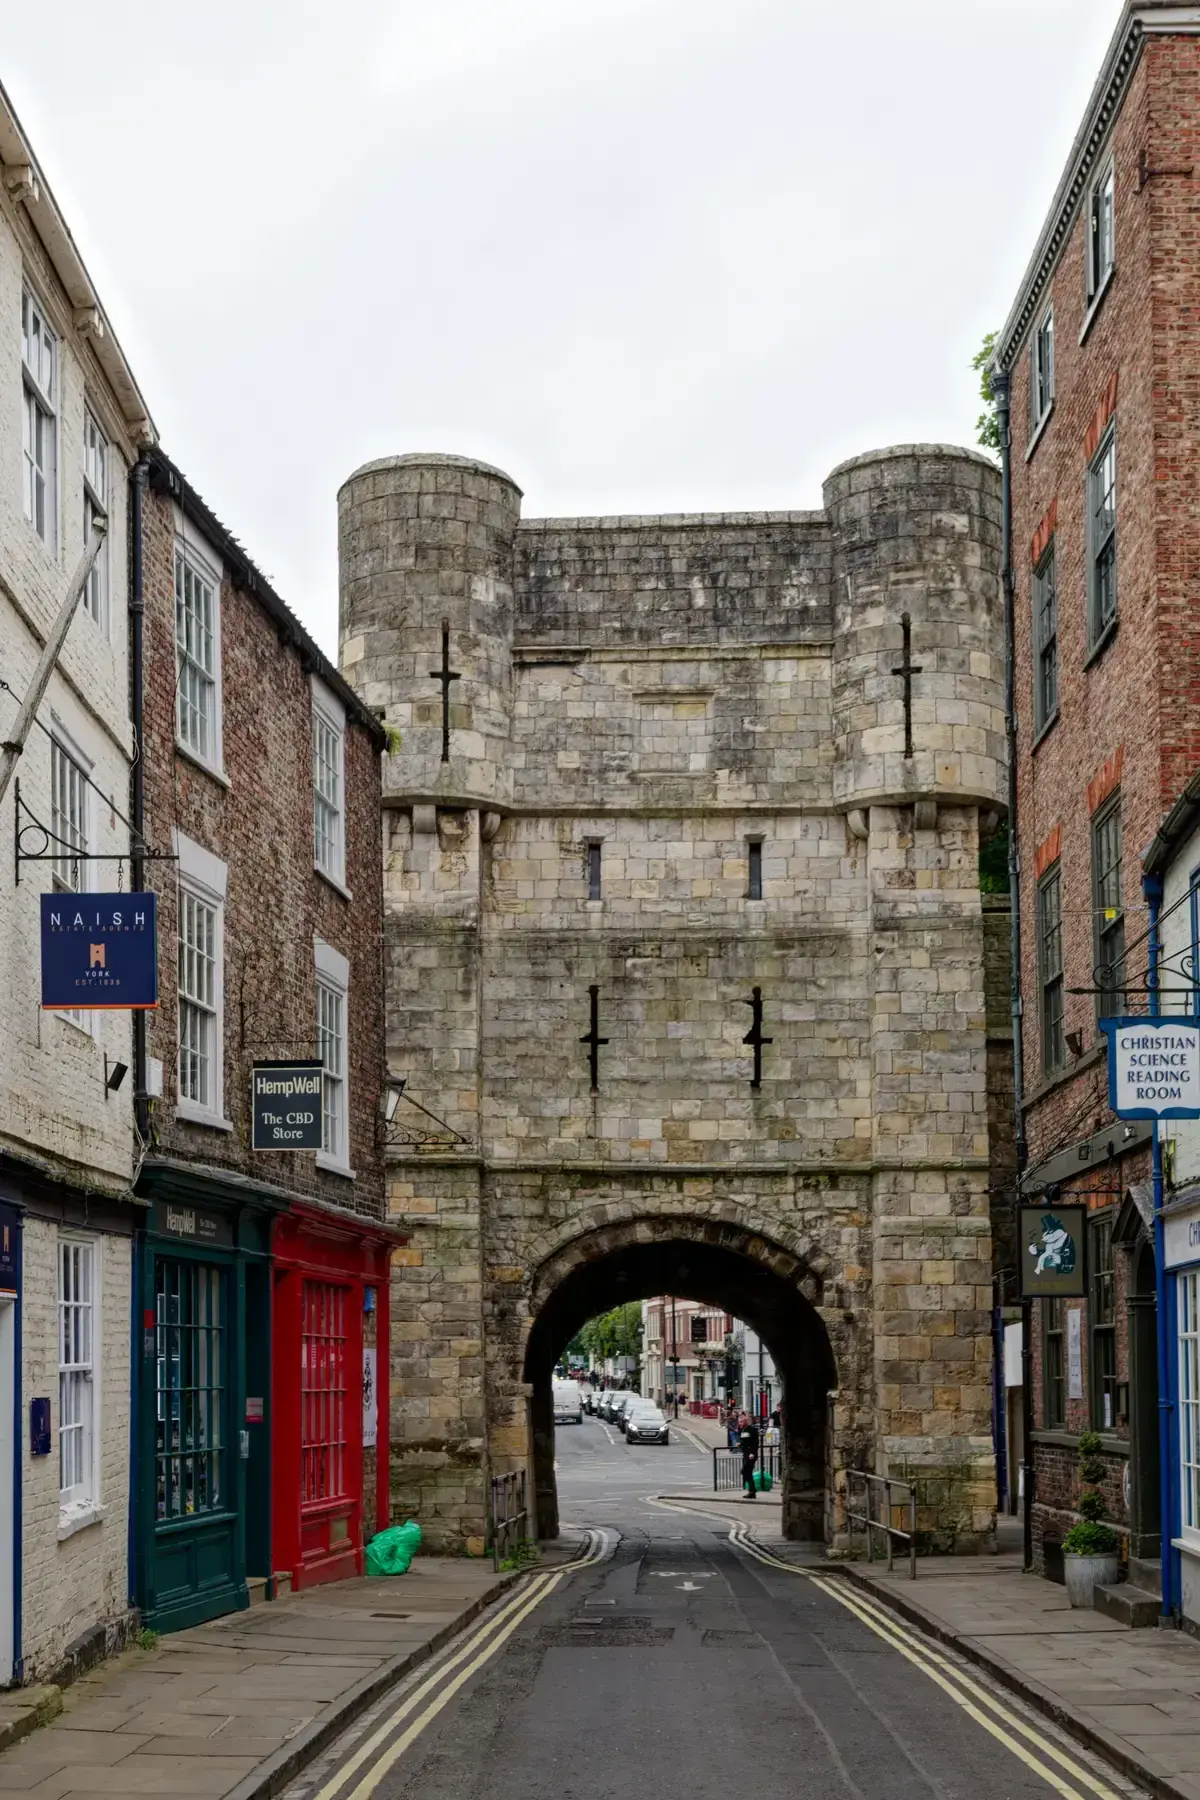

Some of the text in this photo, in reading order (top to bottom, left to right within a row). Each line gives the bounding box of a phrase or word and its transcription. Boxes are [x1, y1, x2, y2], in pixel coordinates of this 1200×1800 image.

[50, 912, 145, 926] NAISH
[85, 970, 110, 978] YORK
[1121, 1036, 1196, 1050] CHRISTIAN
[1130, 1053, 1187, 1066] SCIENCE
[1127, 1070, 1191, 1083] READING
[256, 1076, 320, 1098] HempWell
[1136, 1086, 1182, 1100] ROOM
[261, 1112, 314, 1125] The CBD
[272, 1126, 303, 1139] Store
[166, 1205, 196, 1237] HempWell
